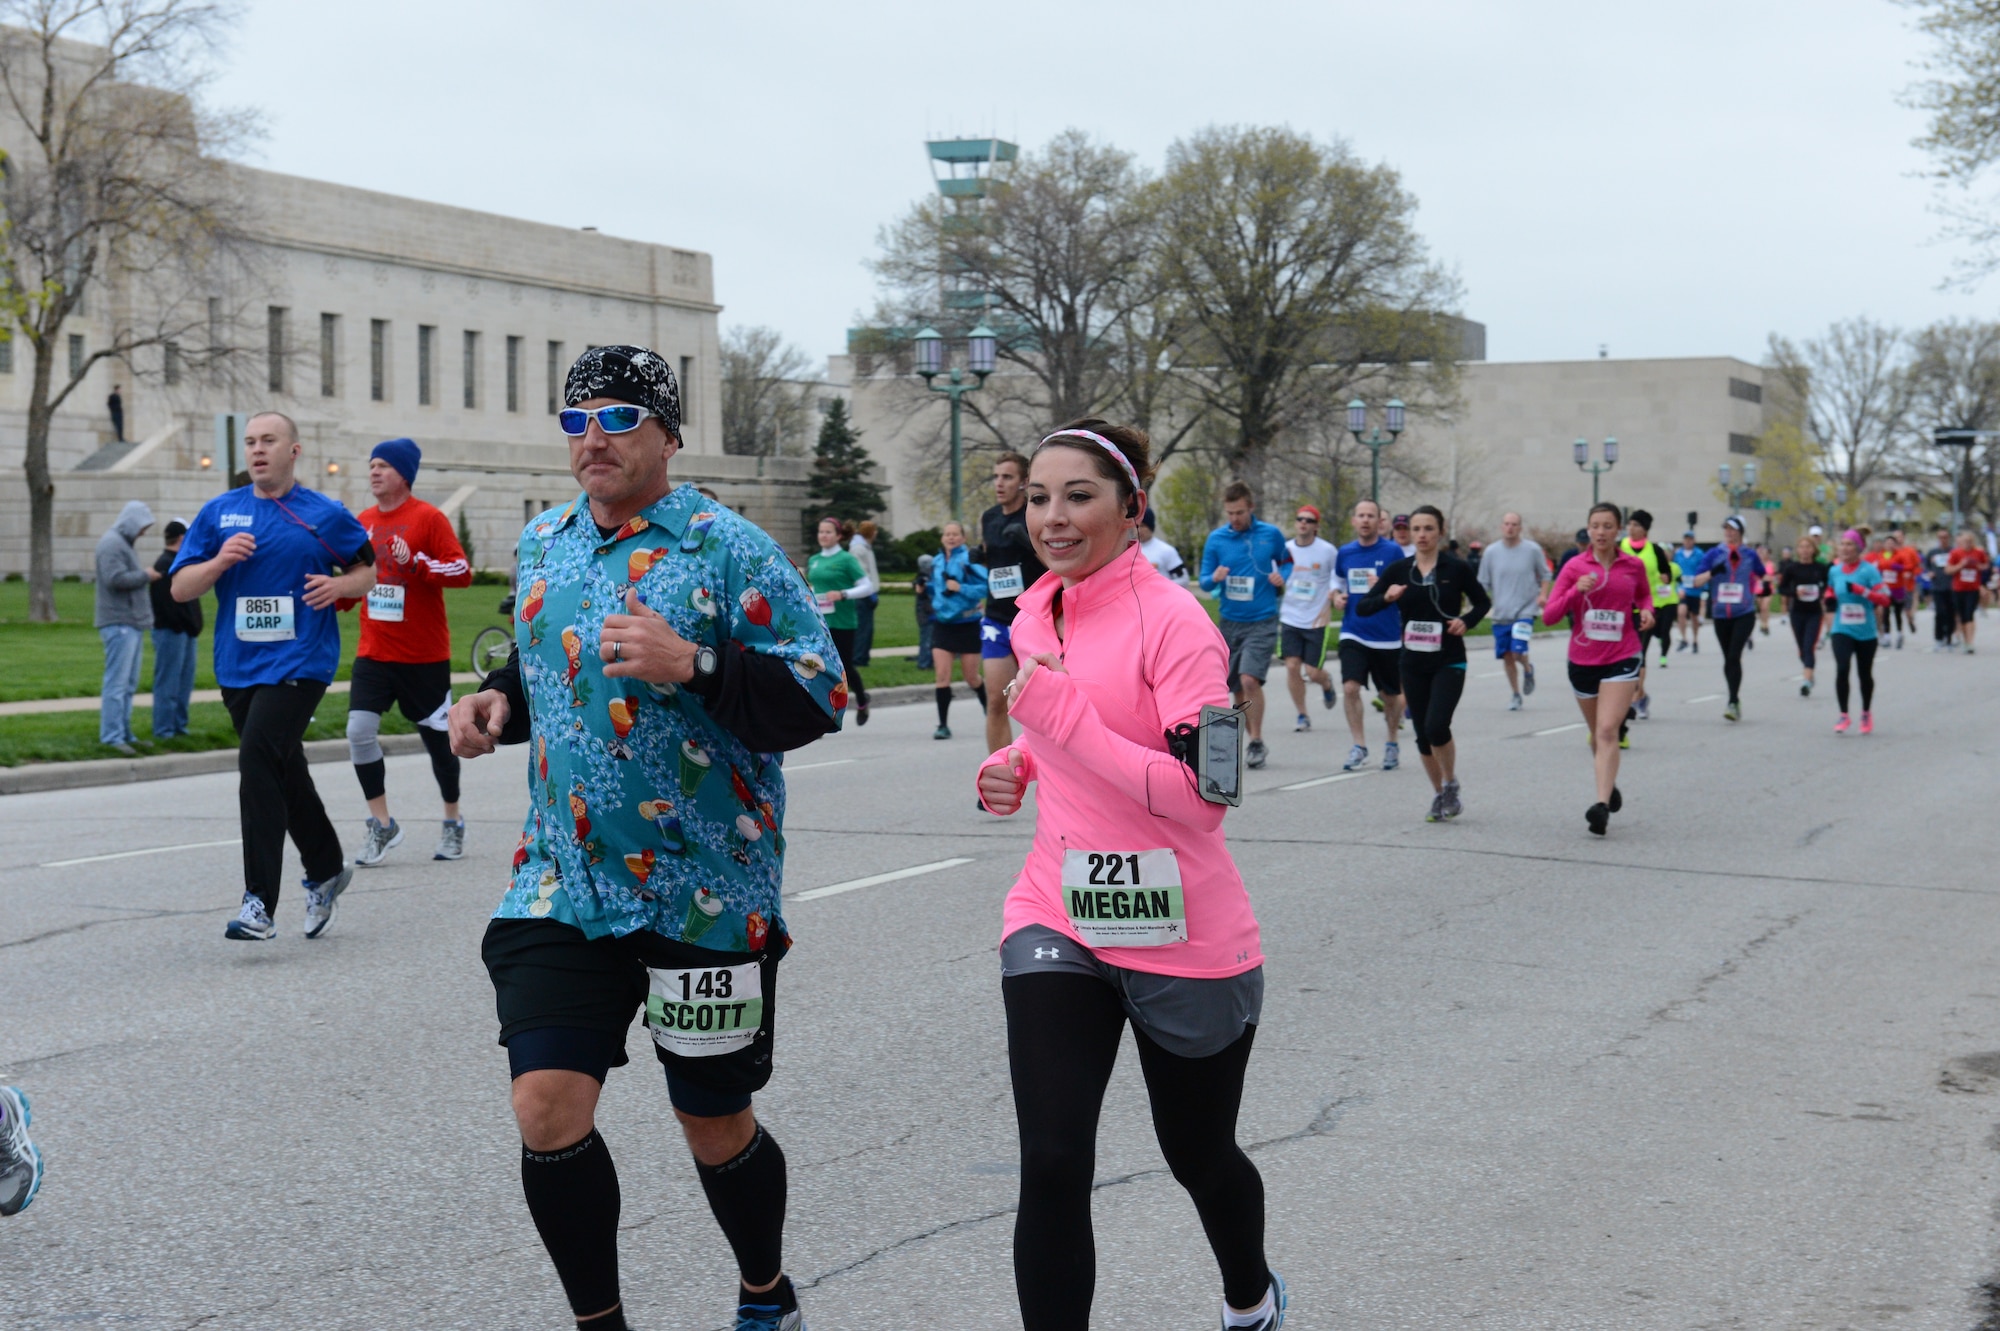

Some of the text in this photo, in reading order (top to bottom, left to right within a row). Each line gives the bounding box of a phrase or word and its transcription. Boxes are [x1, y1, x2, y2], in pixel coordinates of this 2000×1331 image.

[993, 579, 1017, 589] TYLER
[246, 599, 279, 613] 8651
[246, 616, 281, 629] CARP
[1088, 853, 1141, 885] 221
[1072, 890, 1170, 919] MEGAN
[678, 969, 732, 1001] 143
[660, 1002, 747, 1031] SCOTT
[525, 1138, 593, 1162] ZENSAH
